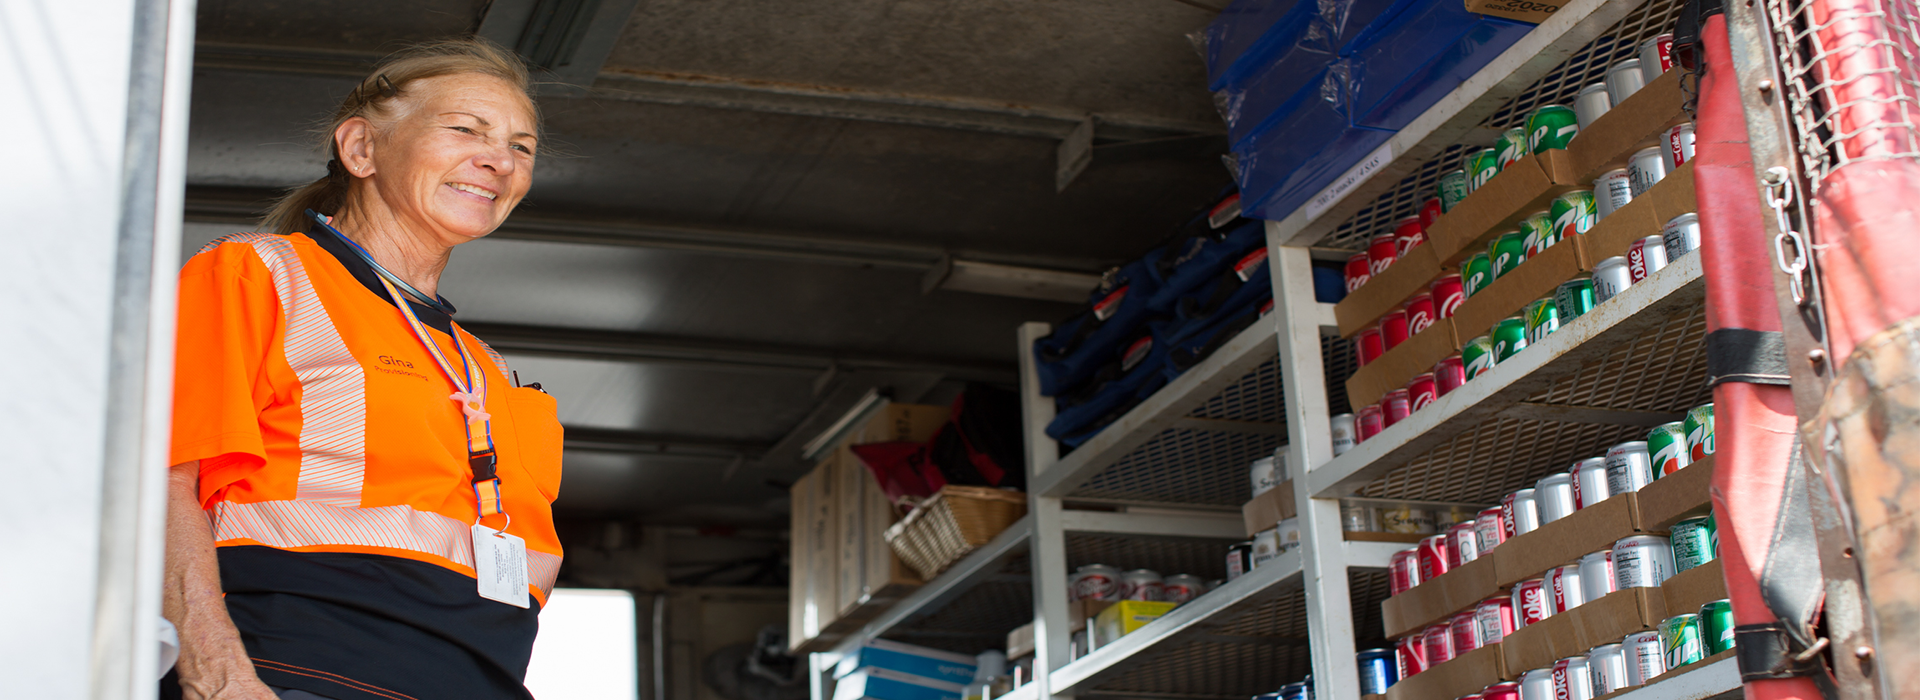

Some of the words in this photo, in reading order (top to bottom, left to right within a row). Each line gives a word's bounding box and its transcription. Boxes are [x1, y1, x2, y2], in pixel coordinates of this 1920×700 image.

[1630, 248, 1648, 284] oke
[378, 355, 414, 369] Gina
[374, 365, 429, 381] Provisioning
